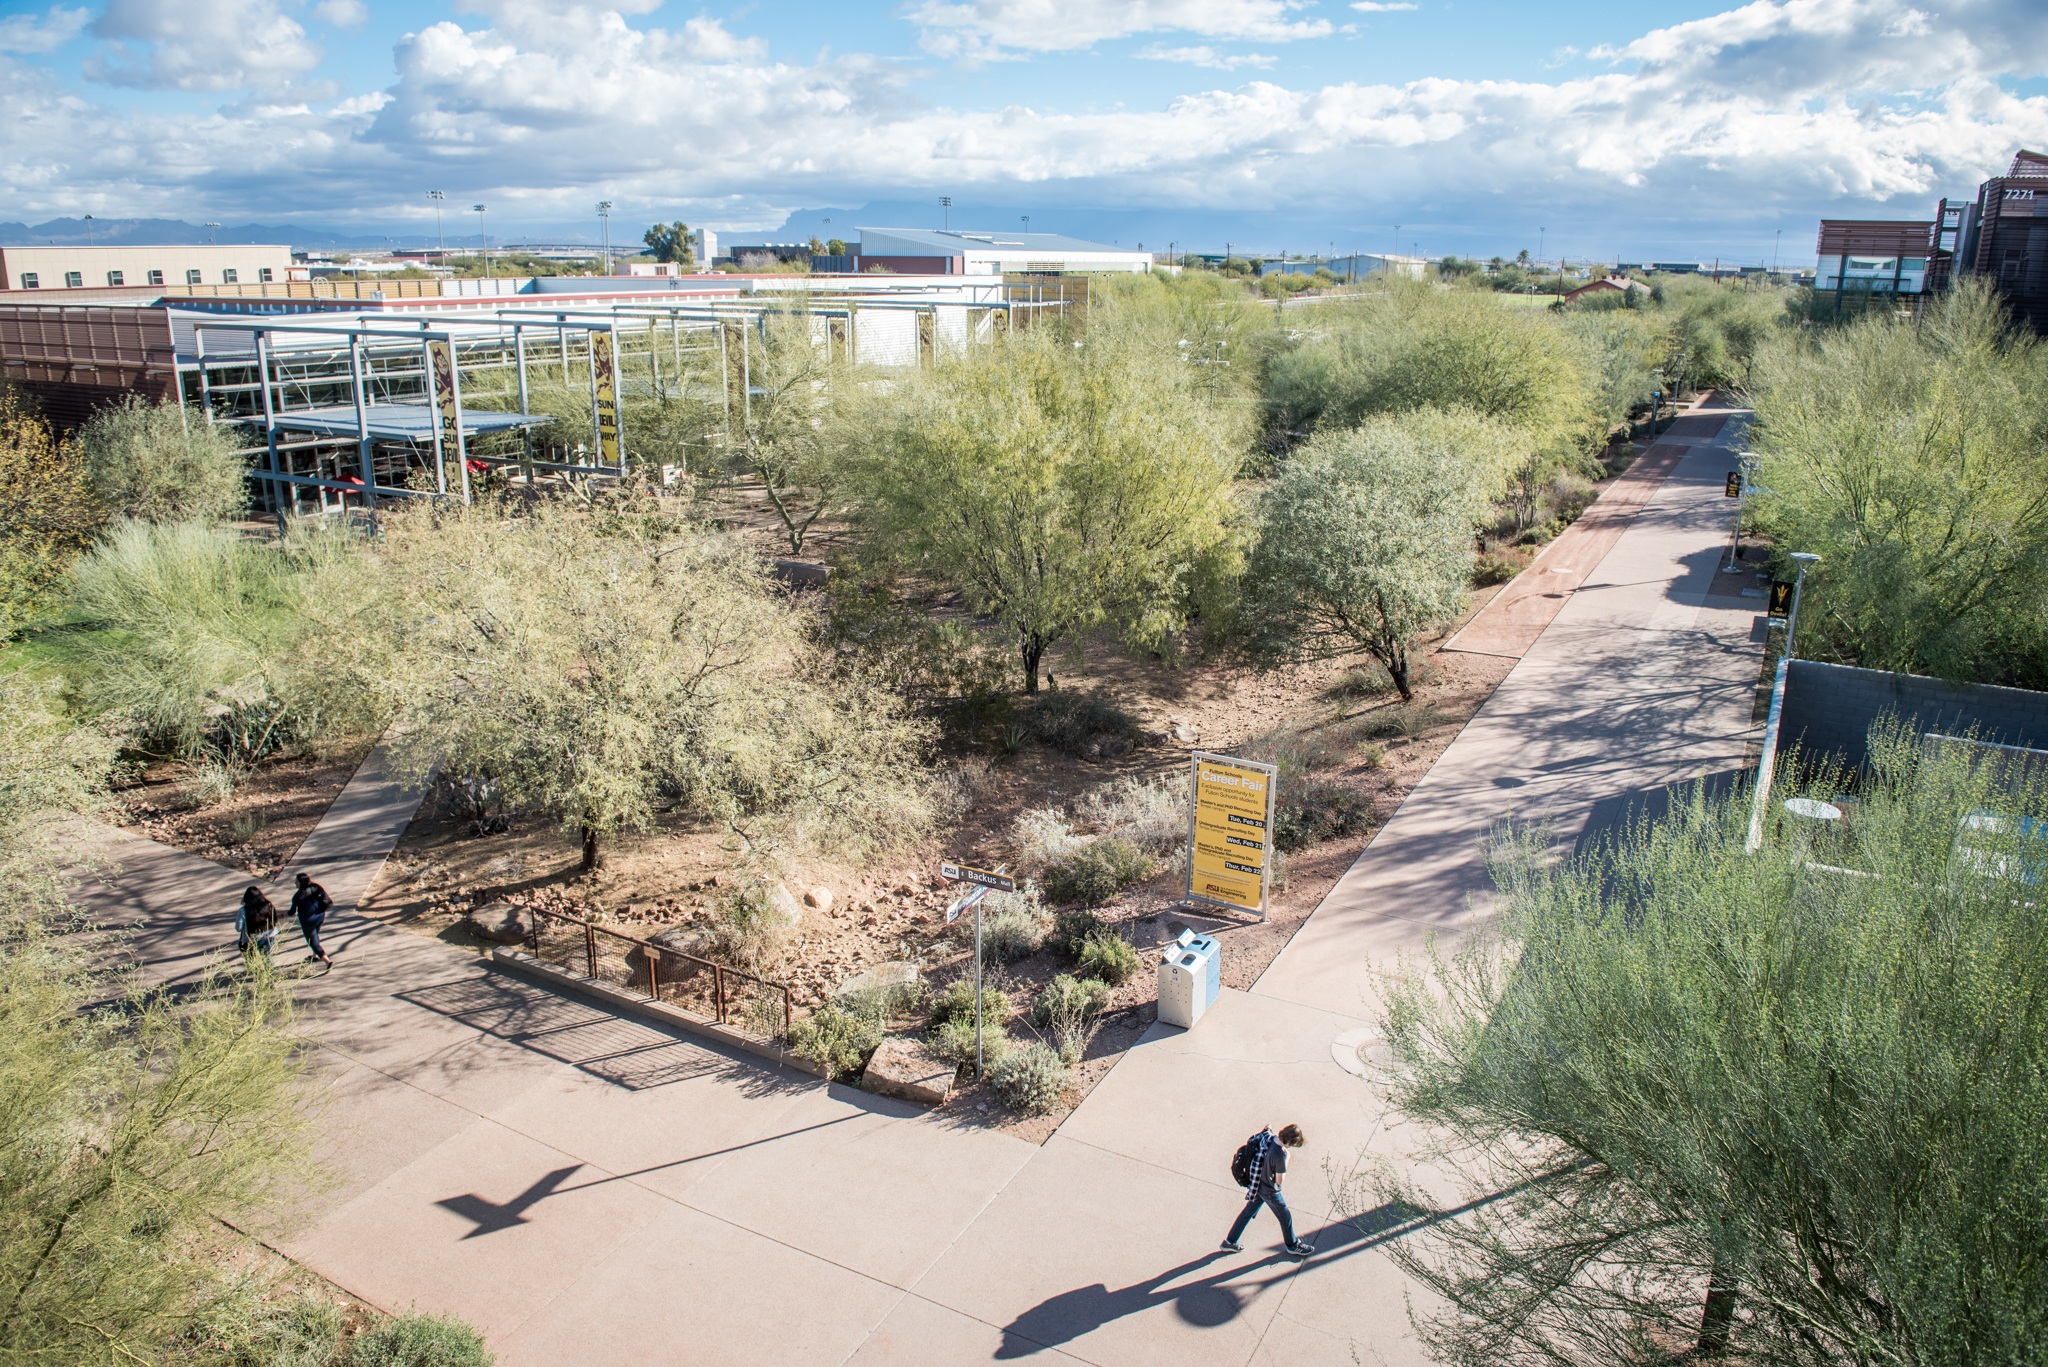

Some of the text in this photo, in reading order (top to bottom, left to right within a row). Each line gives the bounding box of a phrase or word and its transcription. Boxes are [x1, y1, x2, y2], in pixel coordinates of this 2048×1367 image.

[2004, 189, 2034, 200] 7271
[598, 400, 614, 409] SUN
[599, 414, 616, 427] DEVIL
[600, 432, 616, 442] WAY
[1201, 770, 1264, 792] Career Fair
[1201, 783, 1222, 791] Exclusive
[1223, 788, 1248, 797] opportunity
[1220, 792, 1238, 800] Schools
[1239, 796, 1258, 804] students
[1234, 806, 1253, 814] Recruiting
[1226, 852, 1245, 860] Recruiting
[1226, 862, 1240, 870] Thur,
[968, 870, 996, 884] Backus
[1206, 884, 1220, 892] ASU
[1220, 890, 1247, 900] Engineering
